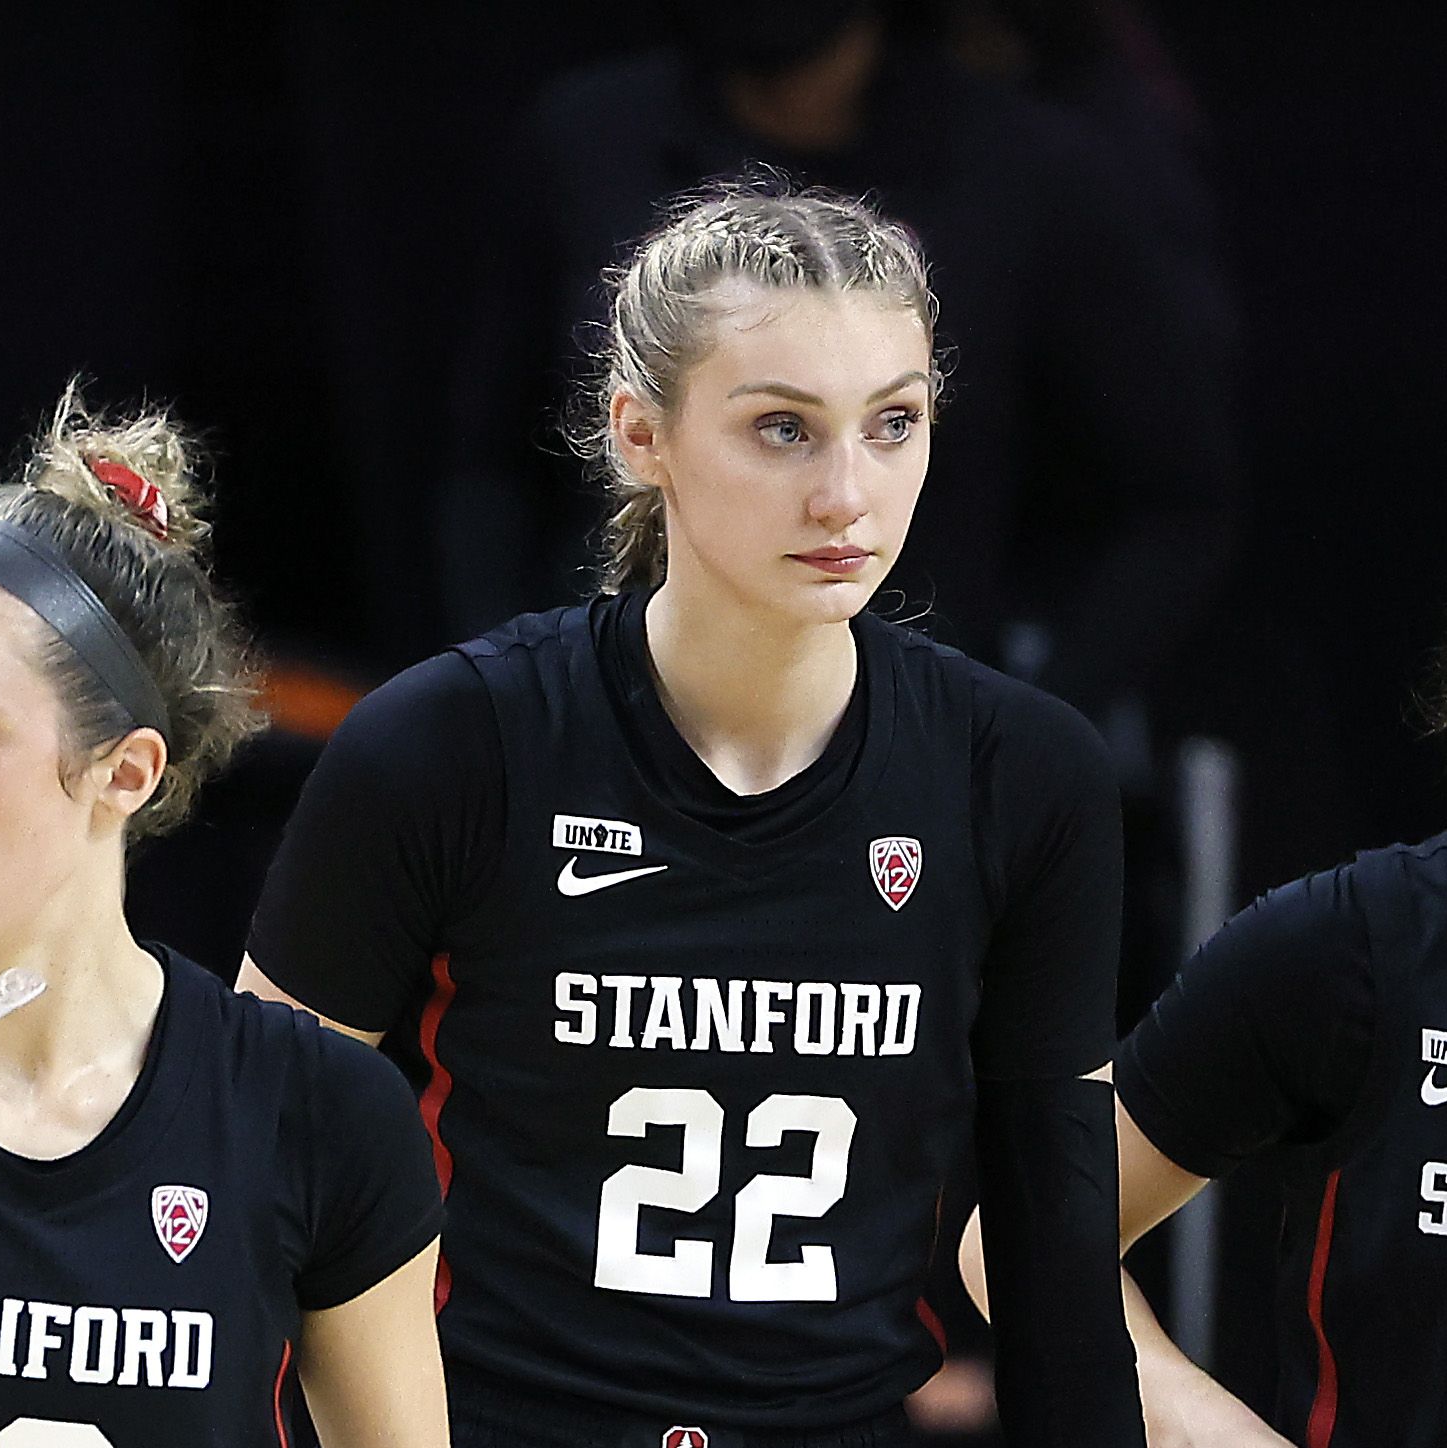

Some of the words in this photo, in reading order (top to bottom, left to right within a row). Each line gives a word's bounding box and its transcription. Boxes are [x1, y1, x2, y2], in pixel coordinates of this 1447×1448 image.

[873, 841, 918, 880] PAC
[884, 867, 908, 893] 12
[555, 973, 921, 1056] STANFORD
[594, 1088, 857, 1301] 22
[166, 1218, 192, 1243] 12
